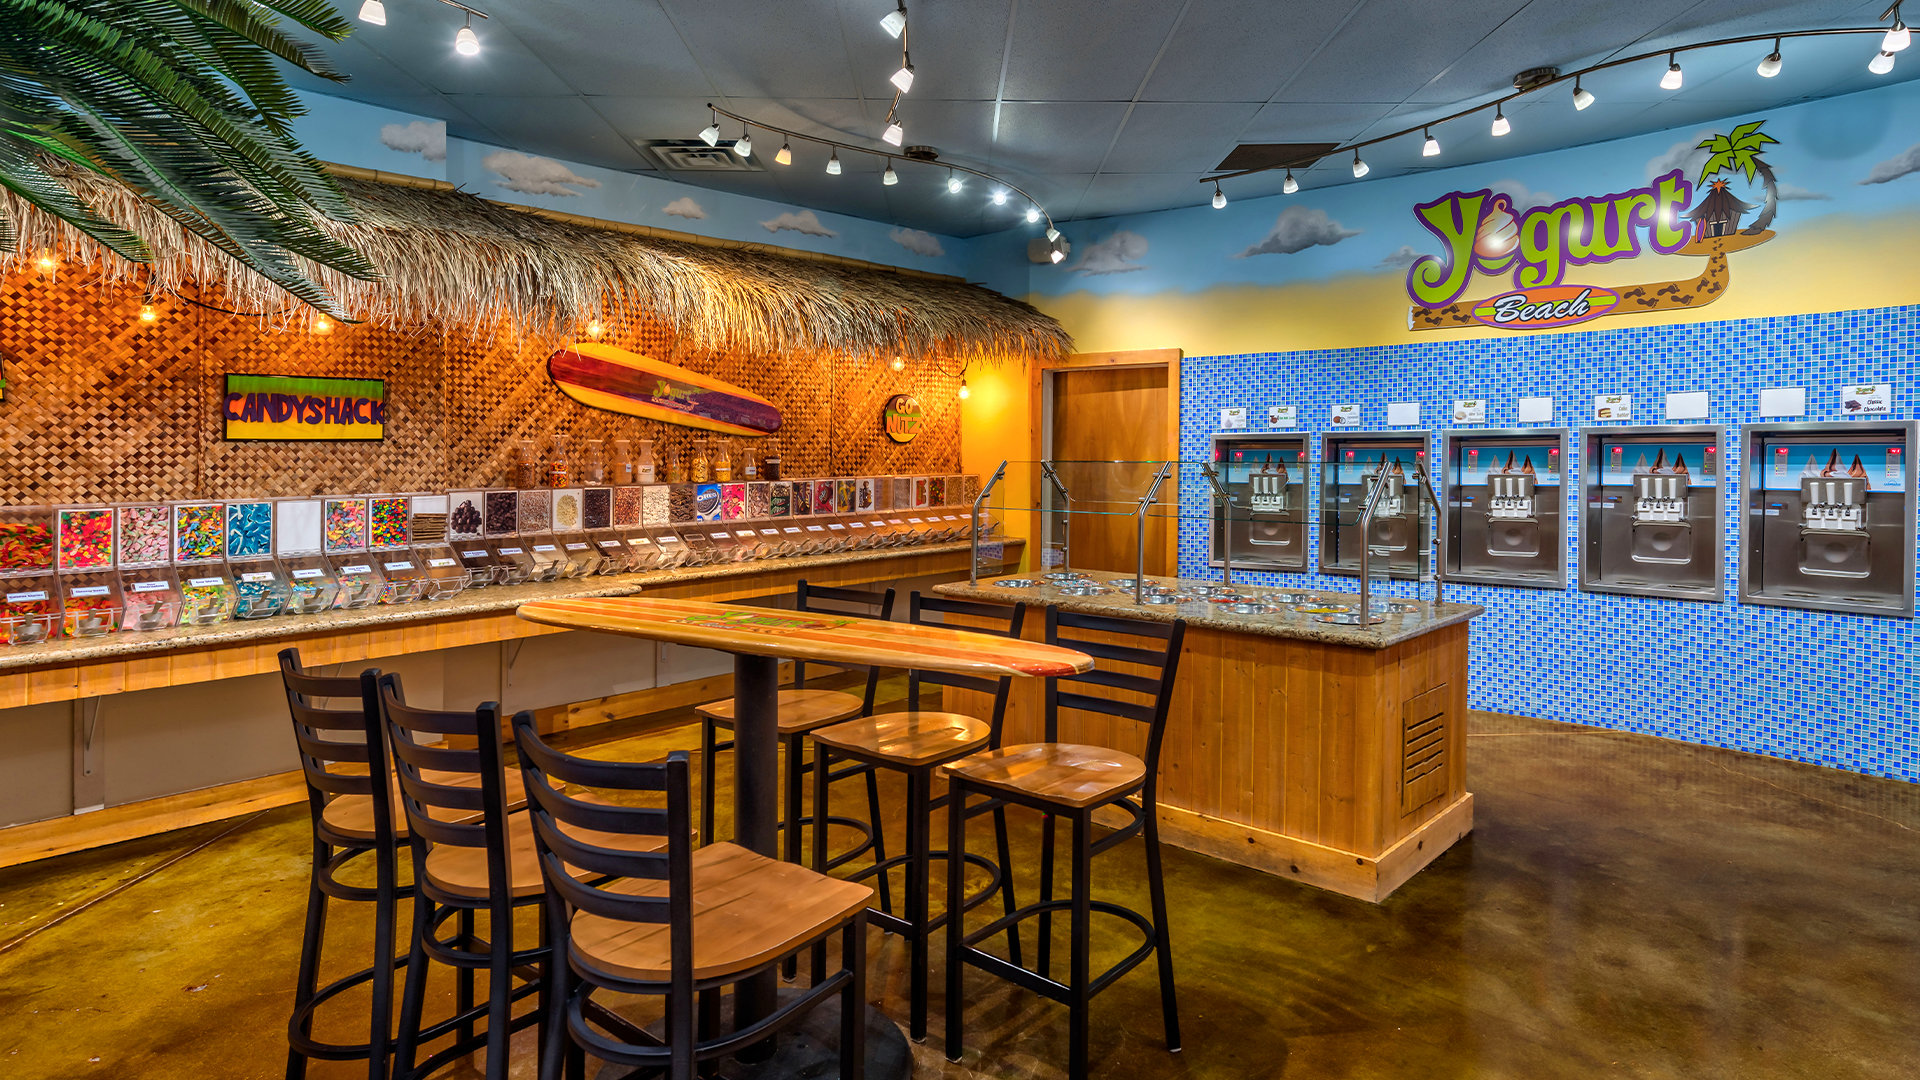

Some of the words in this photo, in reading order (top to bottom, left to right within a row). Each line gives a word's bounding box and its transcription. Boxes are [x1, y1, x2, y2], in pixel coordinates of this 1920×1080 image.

[1408, 171, 1690, 307] Yogurt
[1492, 286, 1591, 325] Beach
[895, 397, 914, 415] GO
[886, 414, 921, 434] NUTZ
